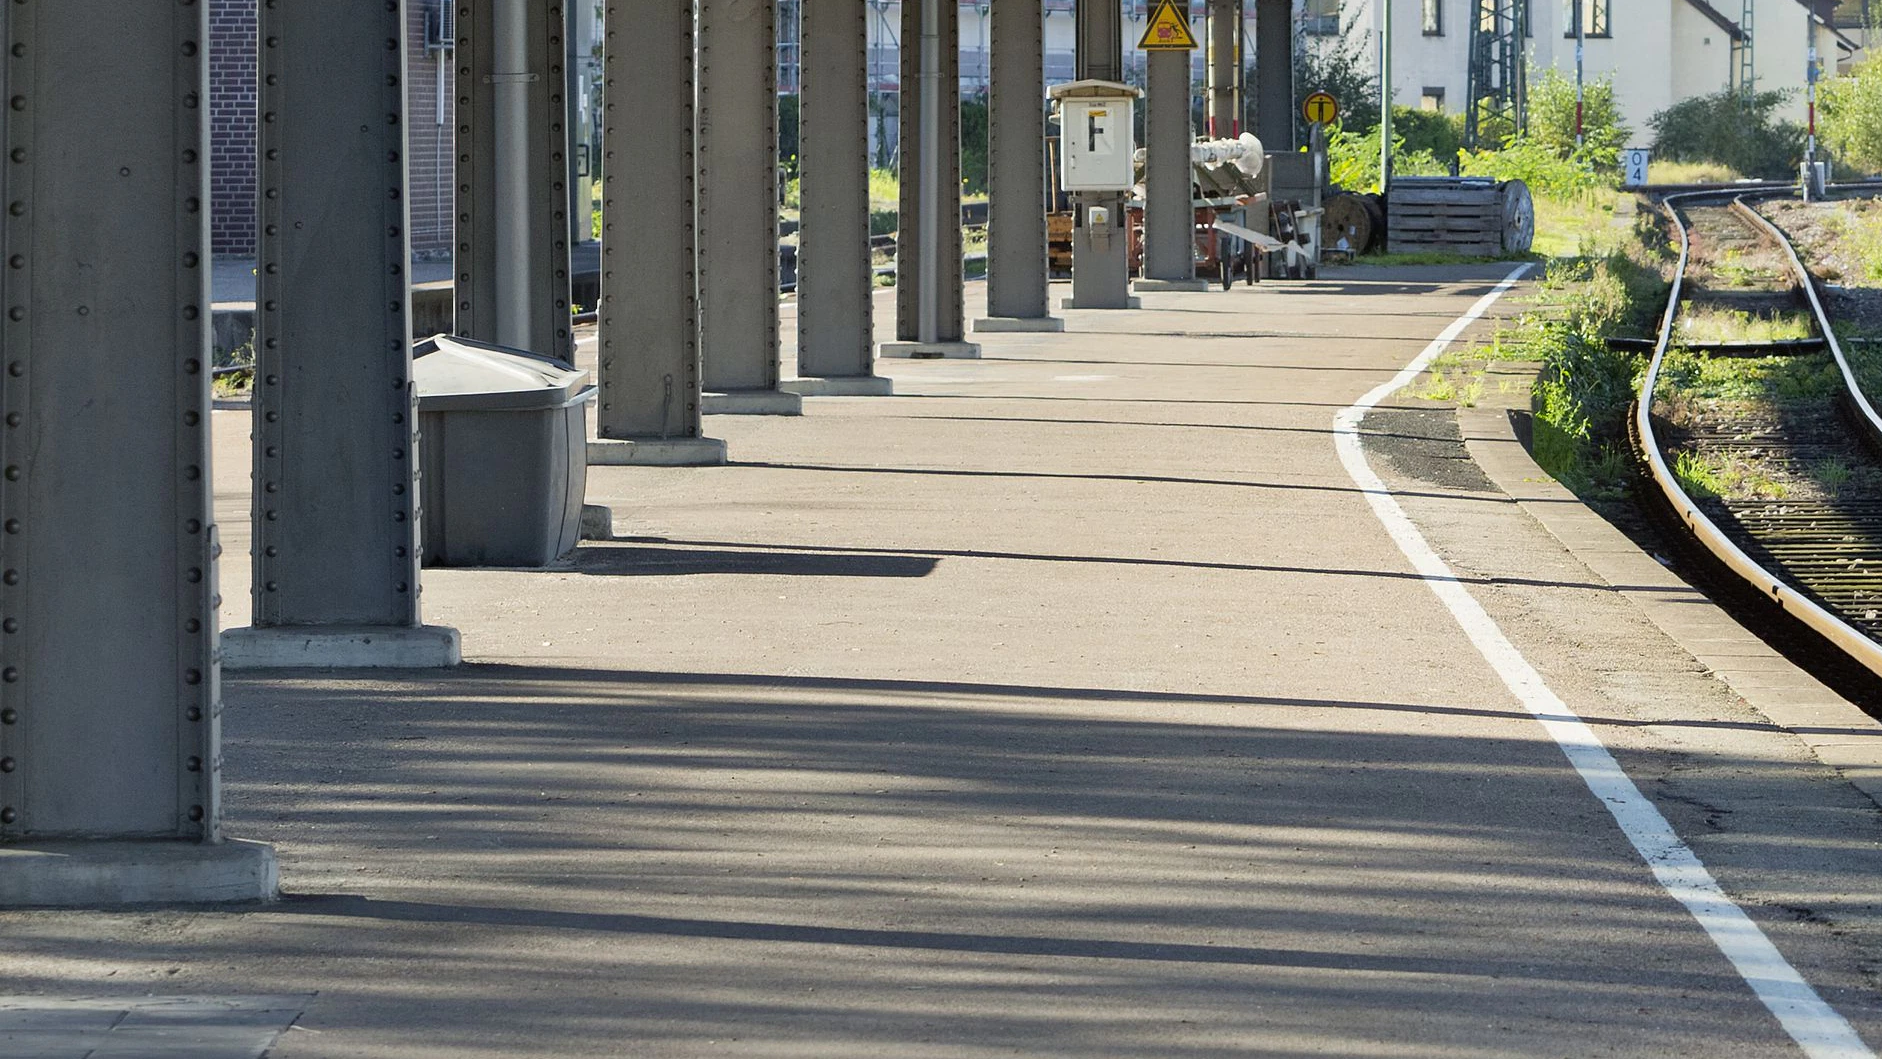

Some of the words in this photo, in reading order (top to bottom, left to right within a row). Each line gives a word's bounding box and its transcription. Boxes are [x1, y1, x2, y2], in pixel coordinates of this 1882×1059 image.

[1088, 110, 1106, 152] F
[1632, 152, 1642, 166] 0
[1633, 168, 1642, 181] 4
